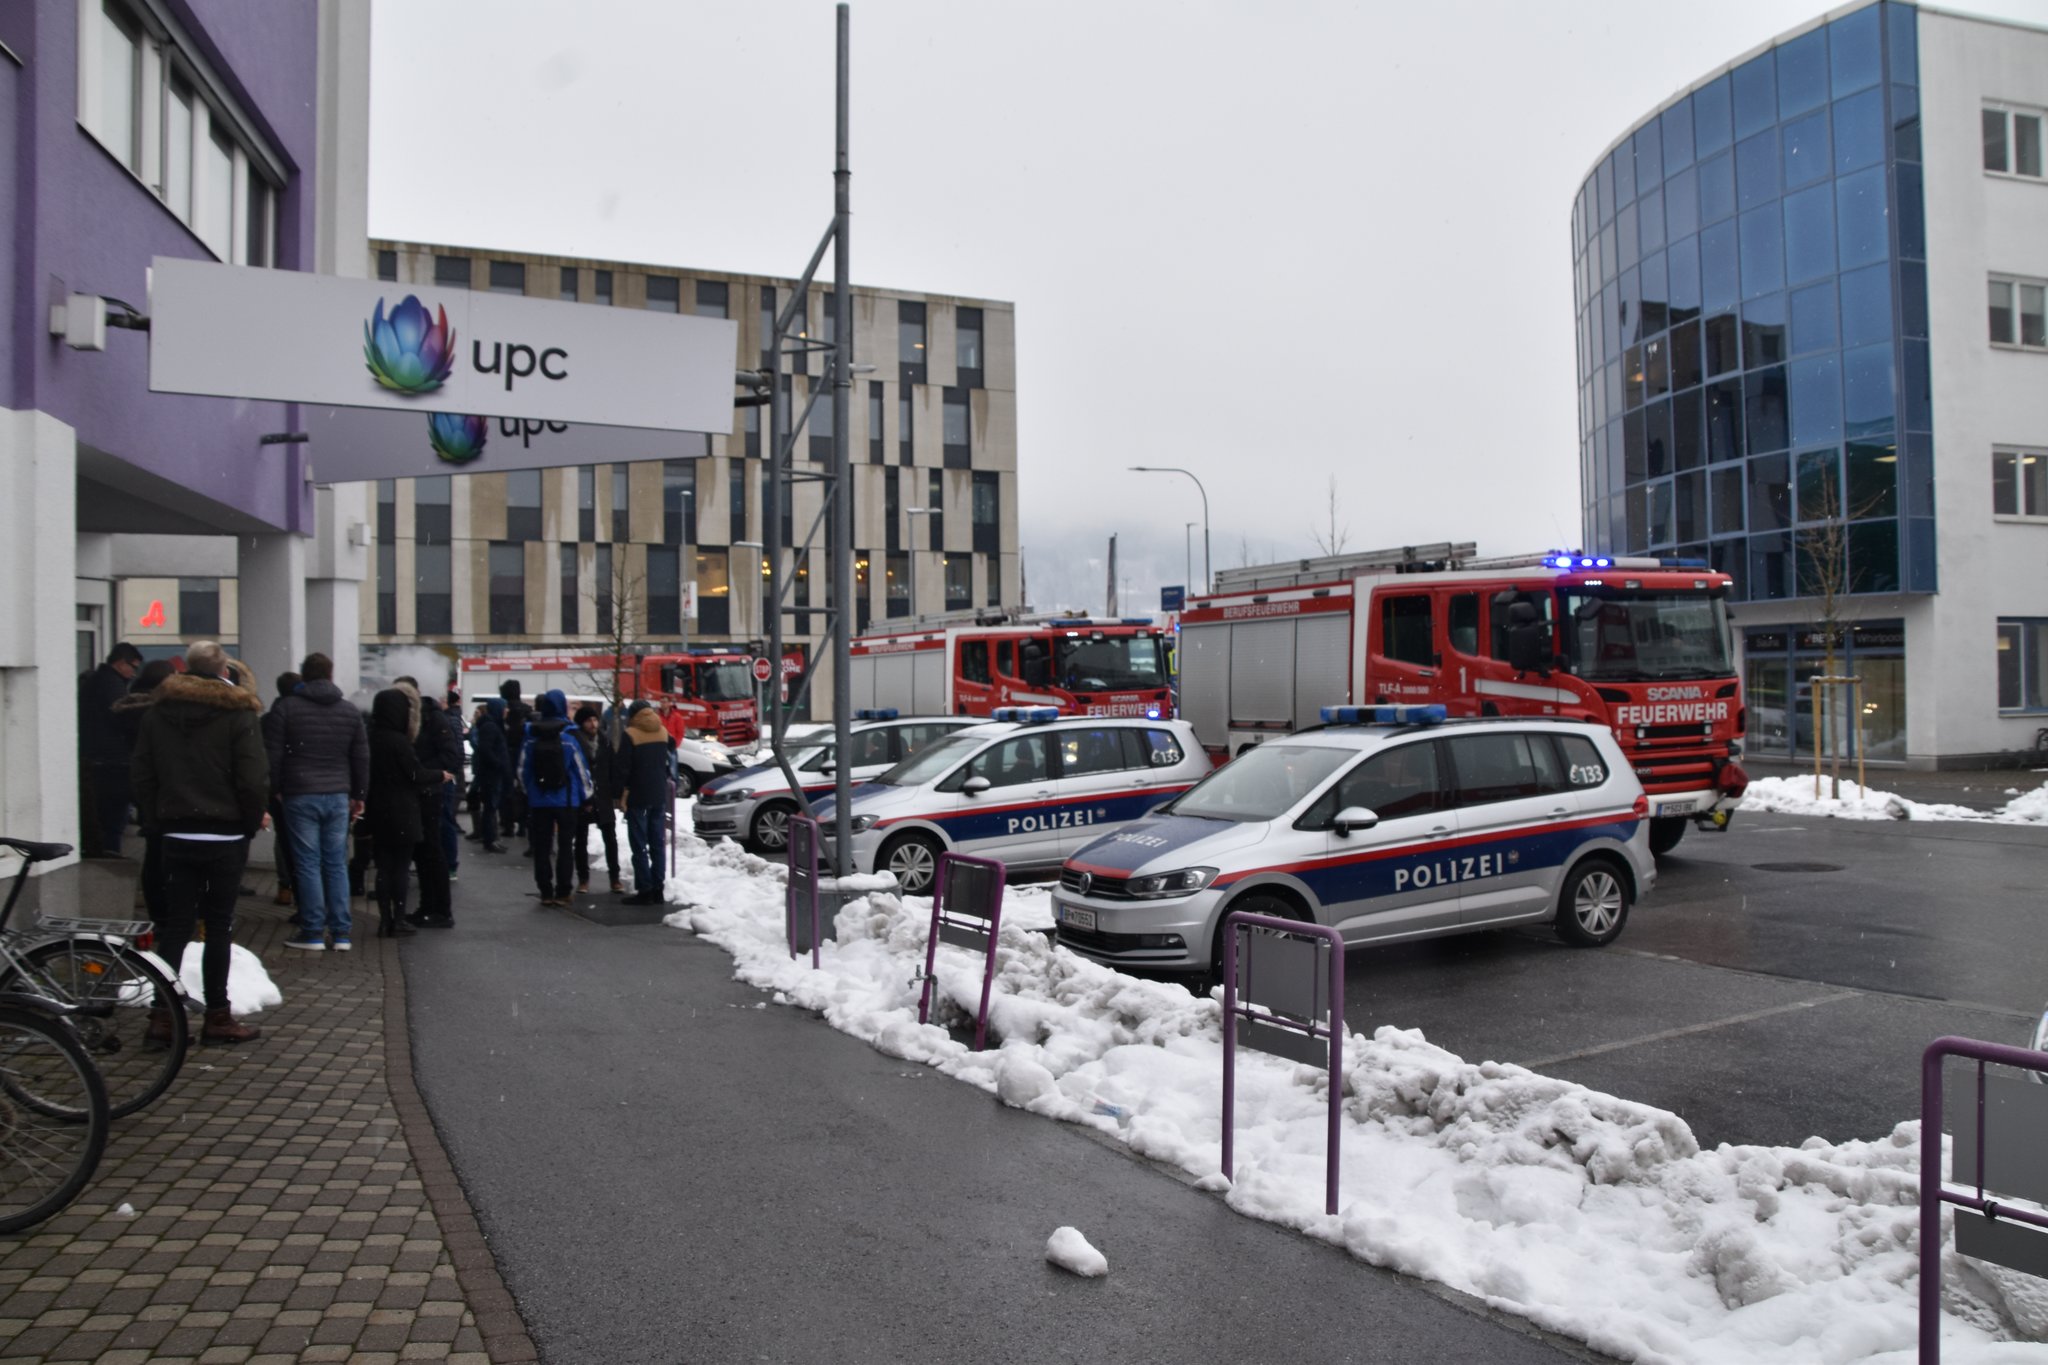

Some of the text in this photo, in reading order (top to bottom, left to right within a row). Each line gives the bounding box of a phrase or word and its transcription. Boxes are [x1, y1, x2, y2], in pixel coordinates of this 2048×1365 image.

[473, 339, 568, 392] upc
[1223, 601, 1300, 619] BERUFSFEUERWEHR
[756, 665, 769, 674] STOP
[1460, 666, 1467, 694] 1
[1001, 685, 1008, 703] 2
[1110, 694, 1139, 703] SCANIA
[1647, 686, 1703, 701] SCANIA
[1087, 702, 1161, 717] FEUERWEHR
[1617, 702, 1728, 725] FEUERWEHR
[1160, 750, 1180, 764] 133
[1579, 764, 1604, 784] 133
[1008, 809, 1093, 834] POLIZEI
[1394, 853, 1503, 892] POLIZEI
